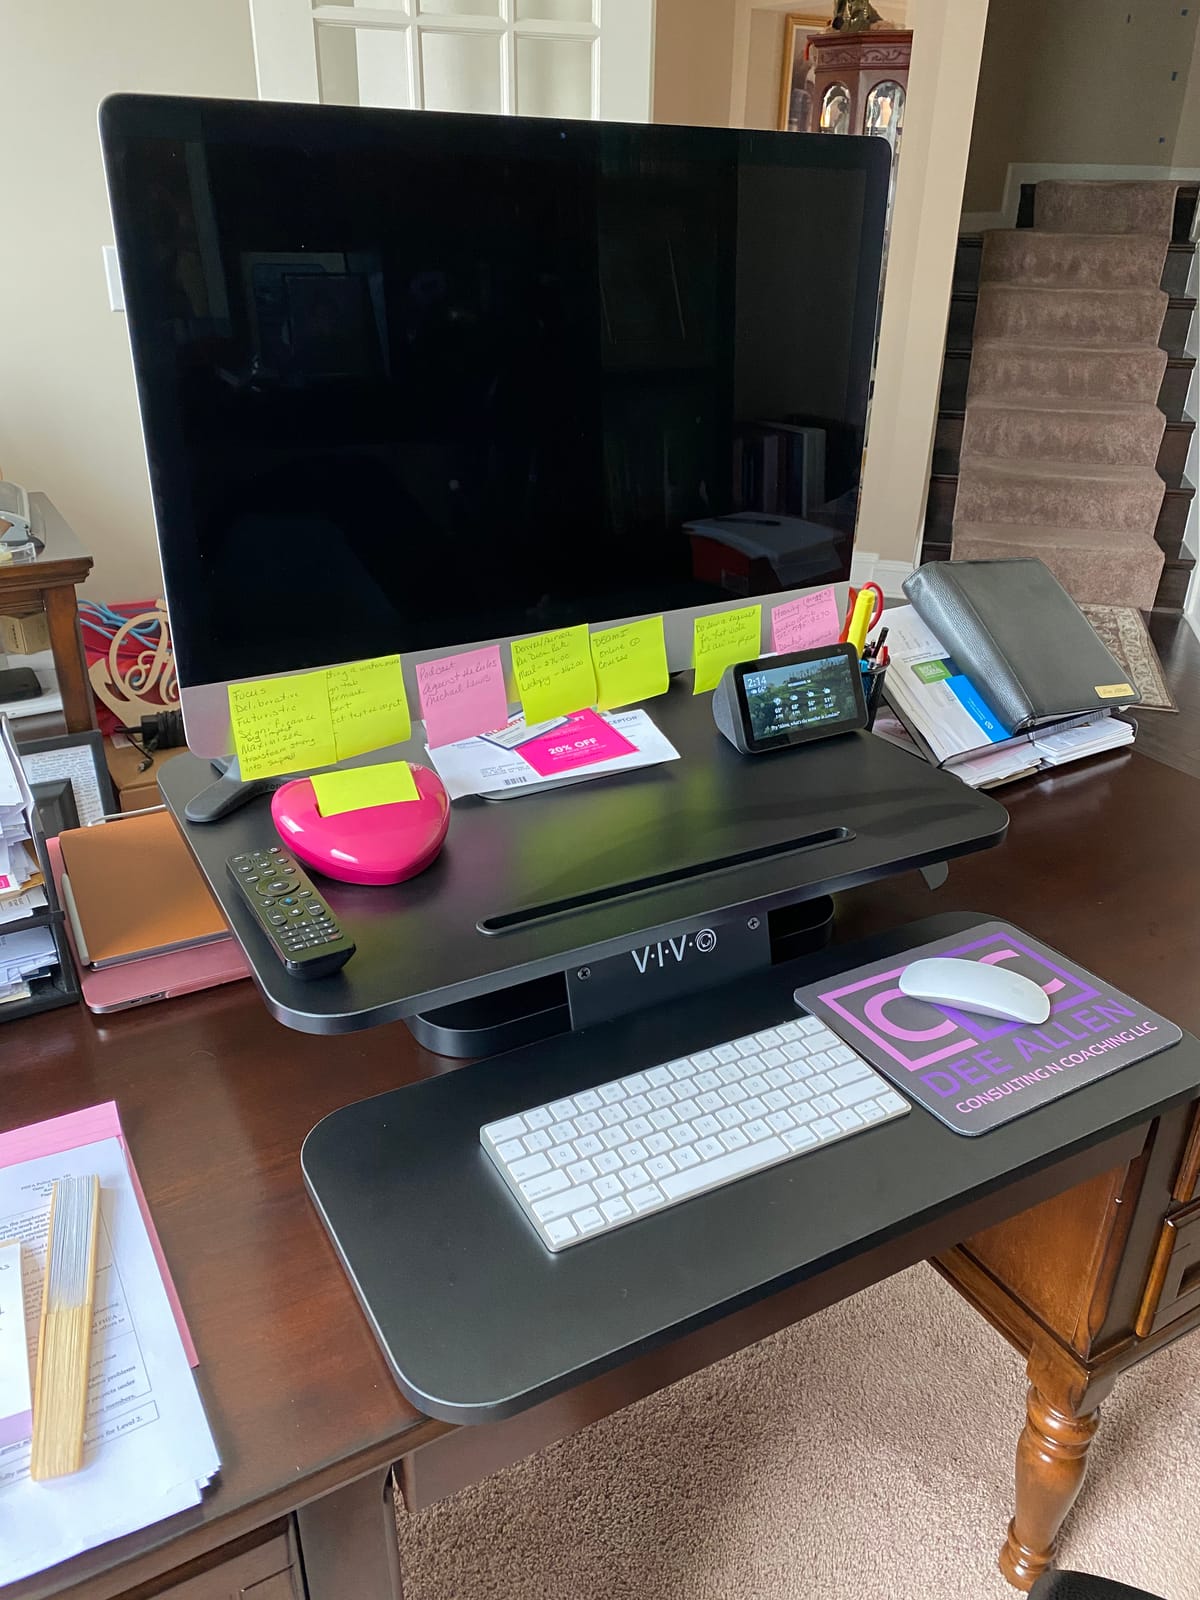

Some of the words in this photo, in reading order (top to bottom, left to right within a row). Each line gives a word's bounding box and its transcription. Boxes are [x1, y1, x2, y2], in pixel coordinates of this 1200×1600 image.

[747, 676, 767, 688] 2:14
[548, 744, 573, 755] 20%
[574, 737, 598, 748] OFF
[920, 1049, 1014, 1098] DEE
[1012, 999, 1136, 1062] ALLEN
[956, 1068, 1050, 1114] CONSULTING
[1045, 1063, 1064, 1075] N
[1060, 1031, 1135, 1068] COACHING
[1129, 1021, 1158, 1037] LLC
